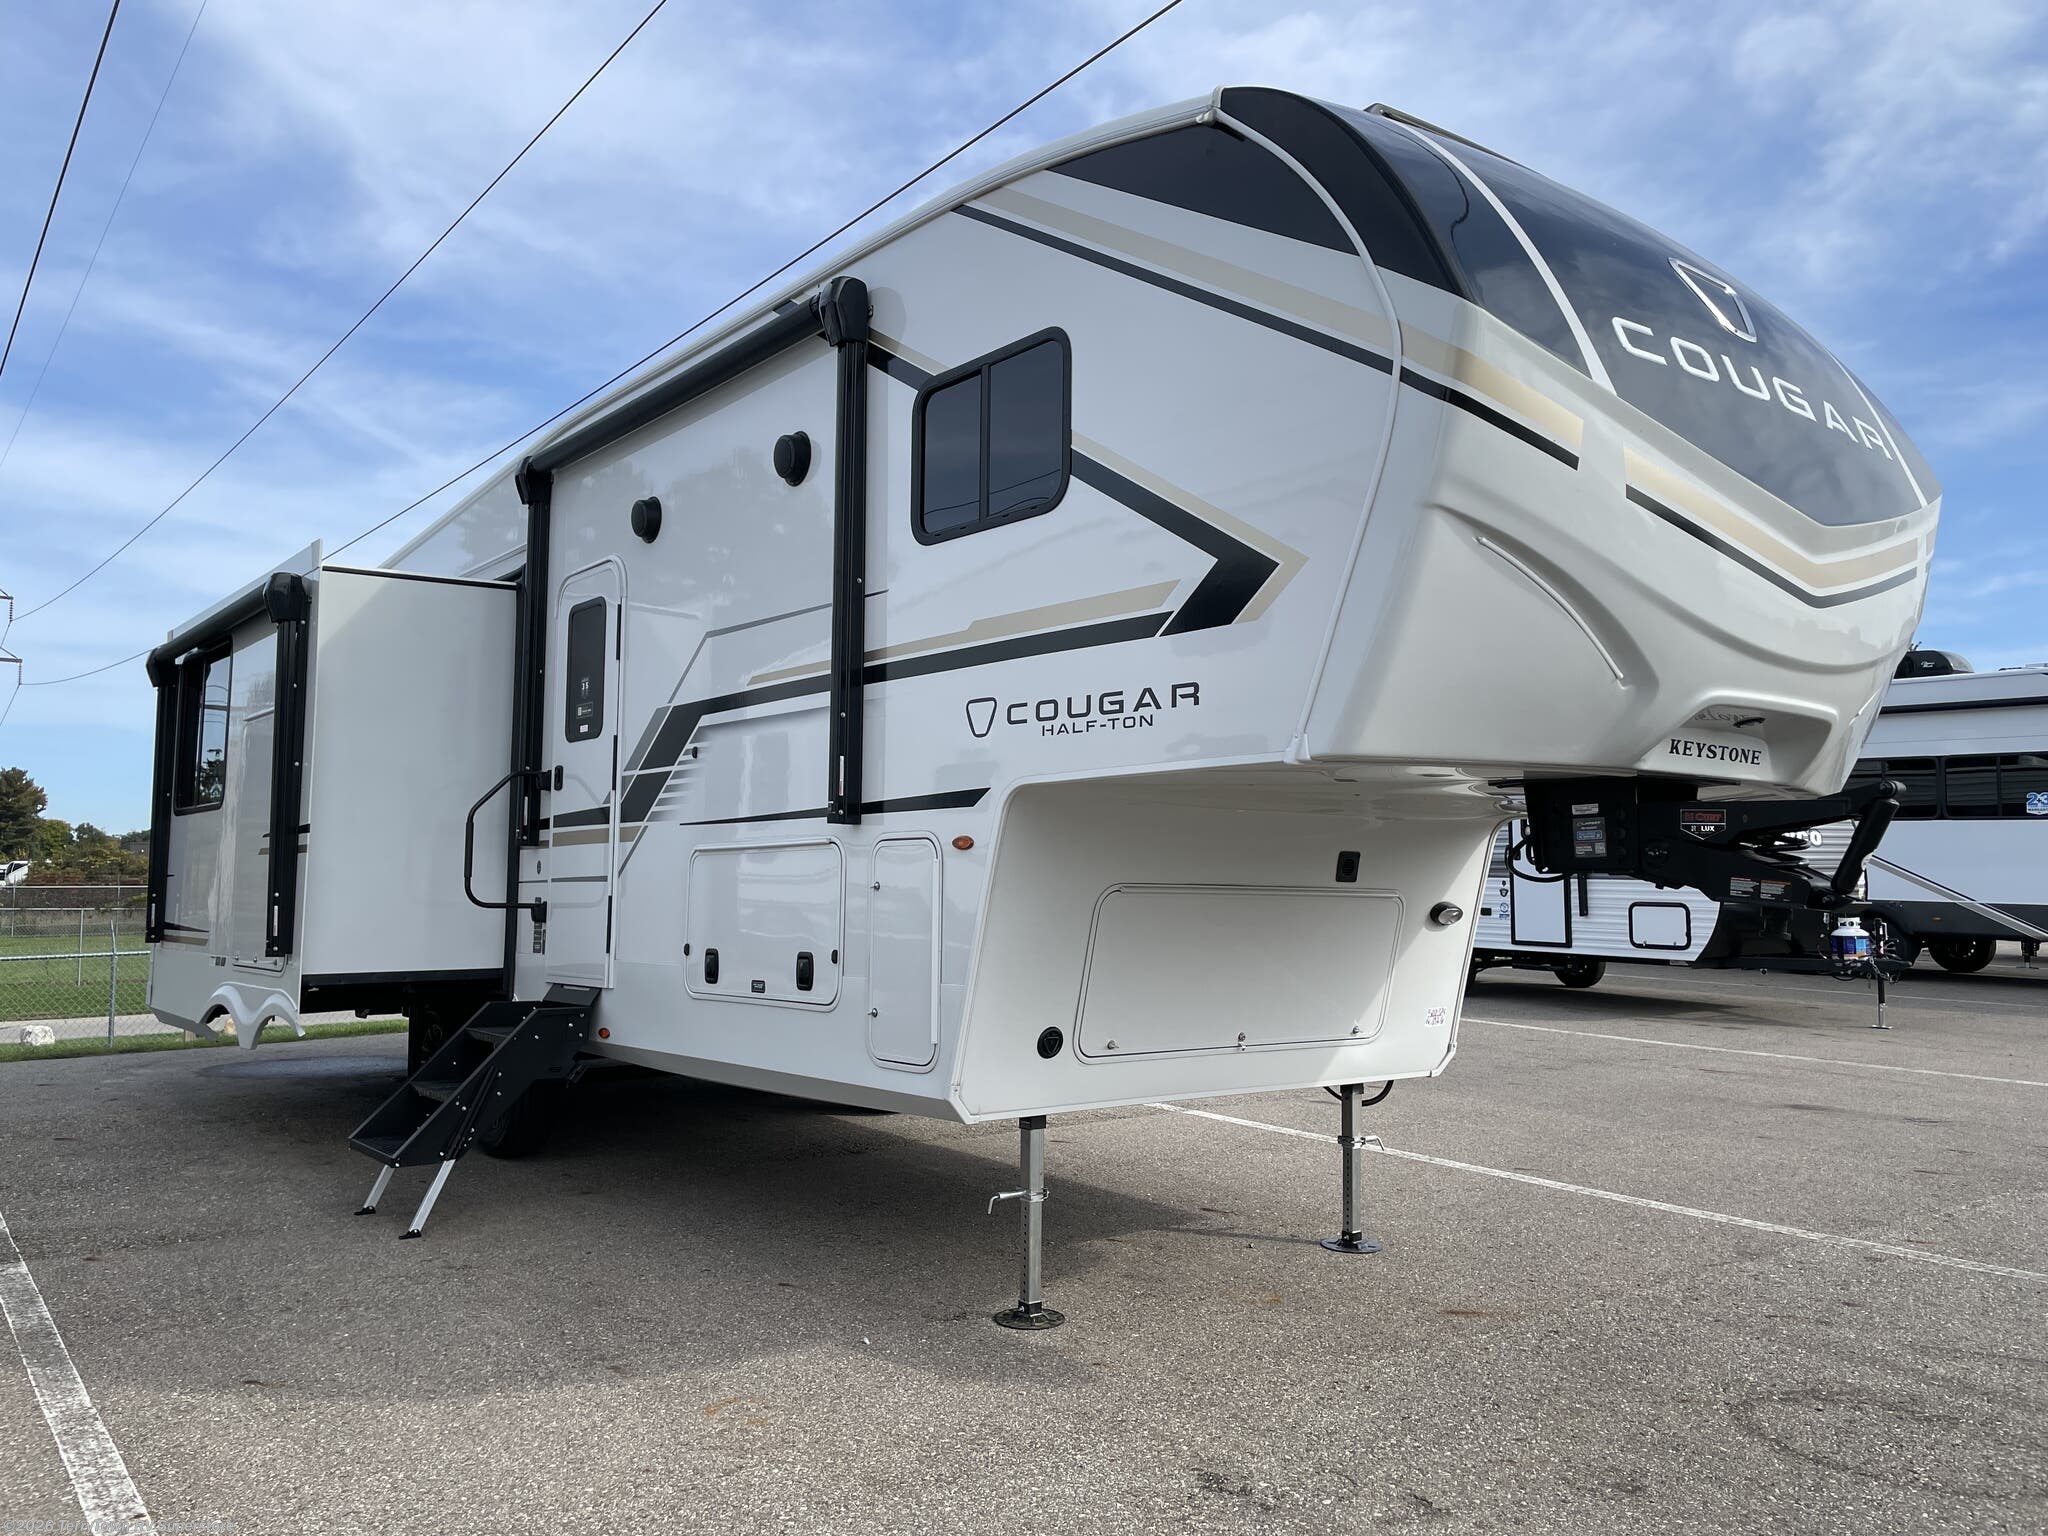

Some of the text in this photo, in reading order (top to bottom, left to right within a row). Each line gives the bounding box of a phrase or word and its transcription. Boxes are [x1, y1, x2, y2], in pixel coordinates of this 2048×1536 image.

[1611, 316, 1894, 461] COUGAR
[1006, 681, 1200, 725] COUGAR
[1041, 714, 1154, 737] HALF-TON
[1669, 738, 1762, 765] KEYSTONE
